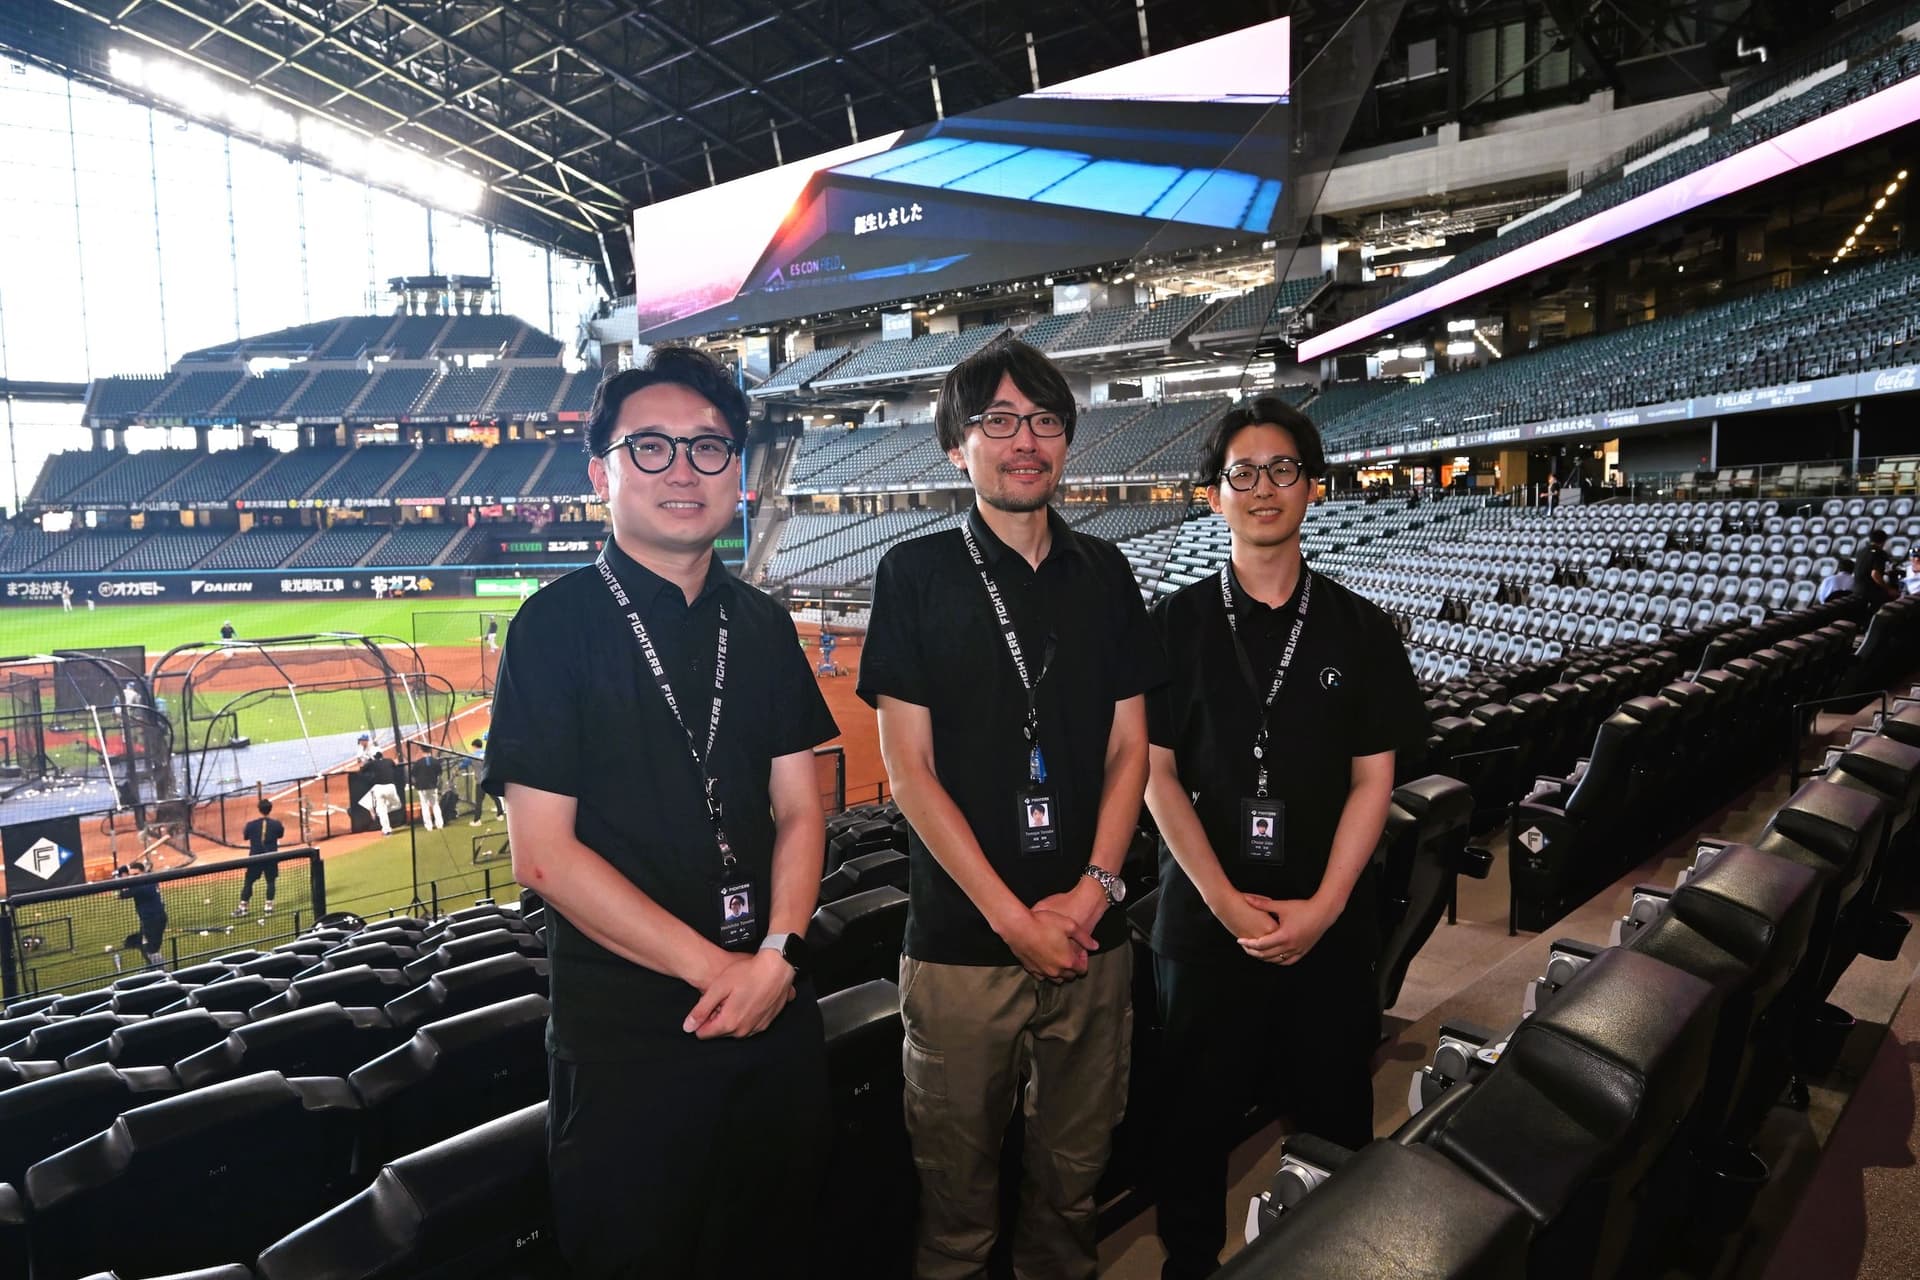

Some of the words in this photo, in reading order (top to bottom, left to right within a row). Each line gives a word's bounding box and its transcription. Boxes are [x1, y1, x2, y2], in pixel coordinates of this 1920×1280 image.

[854, 202, 923, 236] 誕生しました
[203, 582, 253, 593] DAIKIN
[627, 612, 664, 677] FIGHTERS
[715, 628, 729, 690] FIGHTERS
[1280, 618, 1304, 668] FIGHTERS
